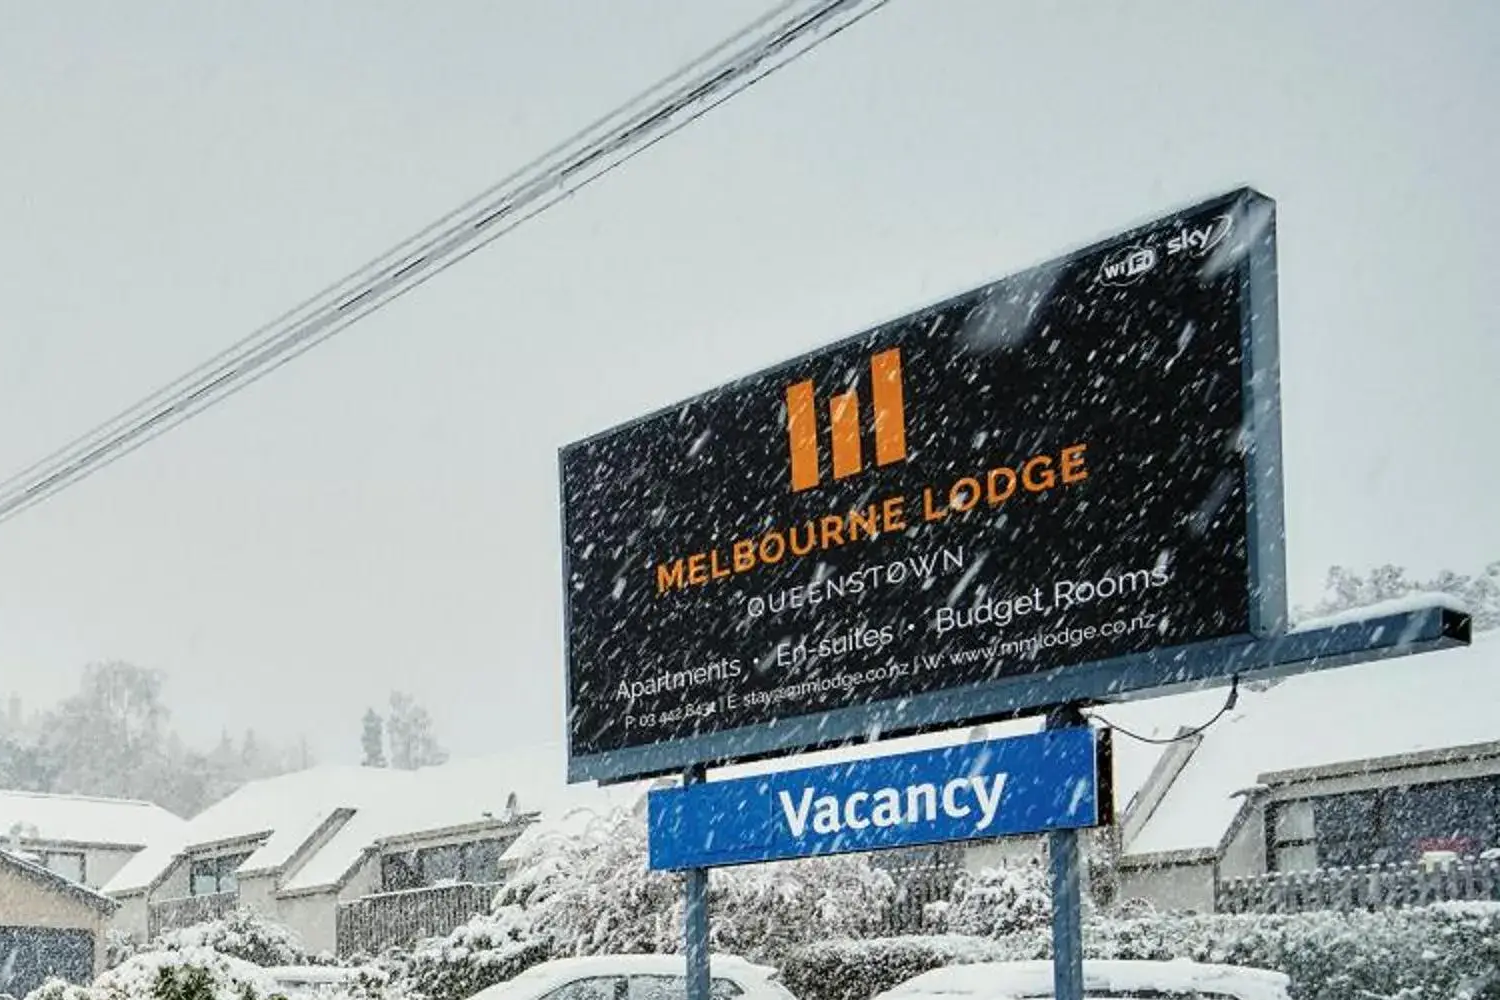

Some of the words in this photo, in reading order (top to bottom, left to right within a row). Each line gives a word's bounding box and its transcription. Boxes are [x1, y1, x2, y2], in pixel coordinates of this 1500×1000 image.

[1167, 224, 1212, 256] sky
[655, 496, 905, 593] MELBOURNE
[924, 443, 1089, 521] LODGE
[748, 546, 964, 618] QUEENSTOWN
[616, 658, 740, 703] Apartments
[776, 622, 893, 667] En-suites
[937, 588, 1043, 633] Budget
[1055, 567, 1168, 607] Rooms
[640, 714, 656, 728] 03
[950, 614, 1156, 664] www.mmlodge.co.nz
[779, 773, 1007, 837] Vacancy
